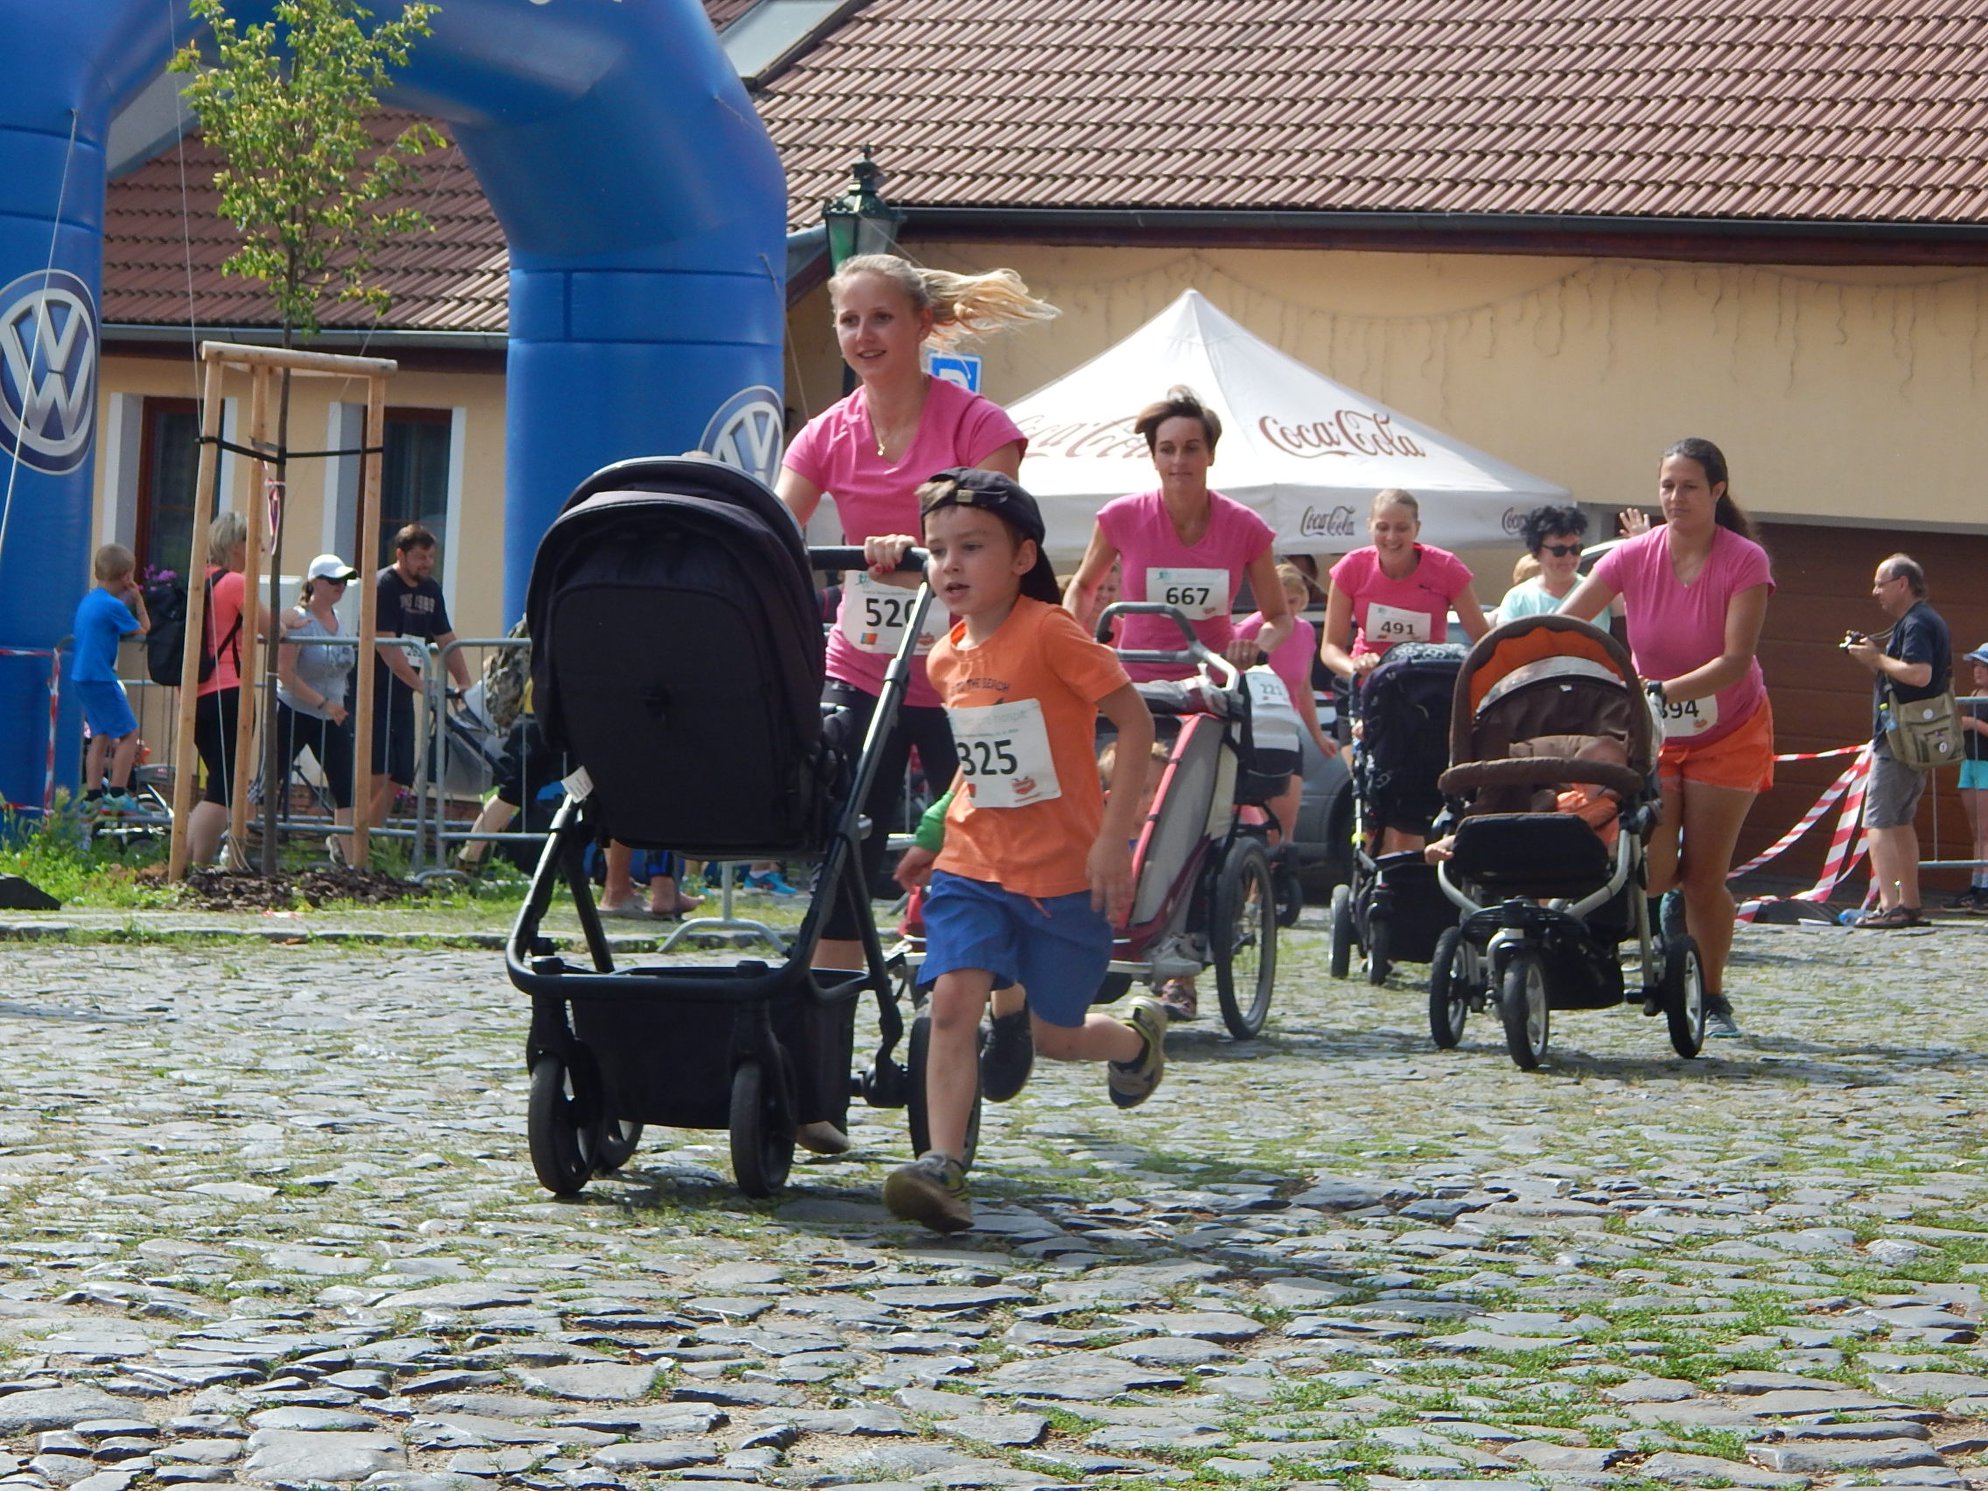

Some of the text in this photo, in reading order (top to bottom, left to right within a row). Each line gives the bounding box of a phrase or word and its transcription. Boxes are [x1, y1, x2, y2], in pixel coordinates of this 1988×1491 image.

[1, 292, 95, 450] VW
[1166, 587, 1210, 606] 667
[1381, 621, 1416, 636] 491
[1662, 700, 1699, 719] 94
[957, 739, 1018, 776] 325
